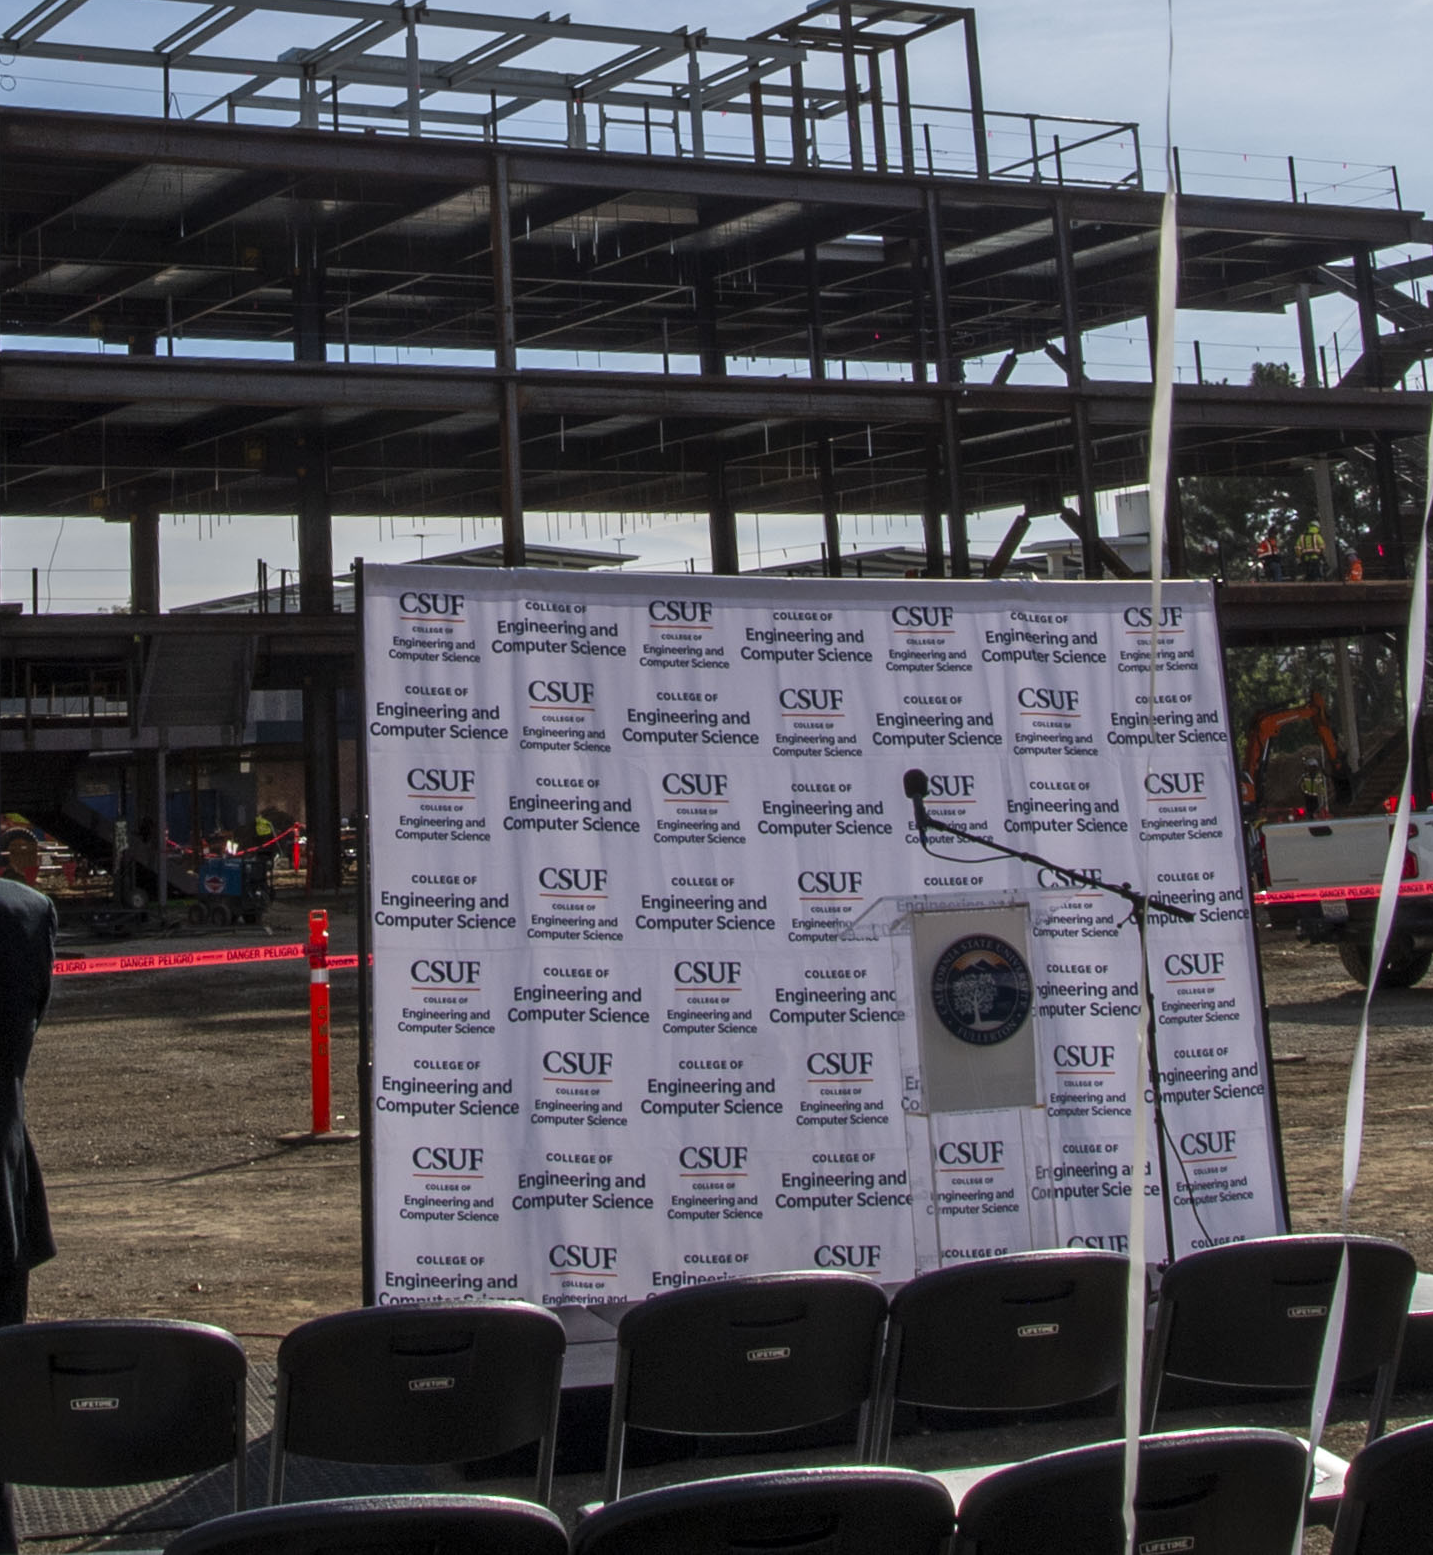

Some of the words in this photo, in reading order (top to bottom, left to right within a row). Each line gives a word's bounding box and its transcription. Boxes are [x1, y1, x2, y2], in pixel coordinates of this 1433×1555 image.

[400, 592, 464, 615] CSUF
[525, 601, 571, 613] COLLEGE
[574, 605, 586, 613] OF
[648, 601, 712, 622] CSUF
[892, 606, 953, 627] CSUF
[497, 618, 587, 639] Engineering
[590, 623, 618, 637] and
[492, 639, 568, 655] Computer
[570, 640, 626, 656] Science
[889, 649, 946, 661] Engineering
[948, 650, 966, 659] and
[886, 662, 934, 673] Computer
[936, 662, 972, 671] Science
[405, 685, 452, 696] COLLEGE
[454, 688, 468, 696] OF
[528, 681, 594, 704] CSUF
[779, 689, 842, 710] CSUF
[1018, 688, 1078, 711] CSUF
[904, 696, 948, 705] COLLEGE
[950, 696, 962, 704] OF
[377, 702, 467, 722] Engineering
[472, 705, 500, 720] and
[876, 712, 963, 729] Engineering
[967, 712, 994, 726] and
[370, 722, 446, 739] Computer
[450, 722, 508, 739] Science
[872, 732, 946, 748] Computer
[948, 731, 1002, 745] Science
[407, 769, 475, 792] CSUF
[662, 773, 727, 795] CSUF
[1030, 781, 1076, 790] COLLEGE
[1078, 782, 1090, 790] OF
[1144, 773, 1204, 794] CSUF
[1007, 798, 1092, 815] Engineering
[1094, 799, 1119, 813] and
[1004, 819, 1073, 834] Computer
[1077, 818, 1128, 832] Science
[1141, 818, 1198, 830] Engineering
[1200, 817, 1217, 826] and
[1139, 832, 1186, 842] Computer
[1188, 830, 1222, 839] Science
[539, 867, 607, 891] CSUF
[672, 877, 718, 887] COLLEGE
[721, 878, 734, 886] OF
[798, 871, 862, 893] CSUF
[642, 895, 734, 913] Engineering
[738, 895, 767, 910] and
[636, 915, 713, 933] Computer
[717, 915, 775, 930] Science
[53, 961, 87, 973] ELIGRO
[120, 957, 155, 969] DANGER
[158, 954, 194, 966] PELIGRO
[226, 949, 261, 961] DANGER
[264, 946, 299, 958] PELIGRO
[1164, 953, 1224, 976] CSUF
[411, 960, 480, 983] CSUF
[544, 967, 592, 977] COLLEGE
[596, 969, 609, 977] OF
[674, 961, 741, 983] CSUF
[514, 984, 608, 1005] Engineering
[612, 987, 641, 1002] and
[403, 1008, 467, 1022] Engineering
[470, 1010, 490, 1020] and
[508, 1008, 586, 1023] Computer
[589, 1007, 650, 1023] Science
[398, 1022, 452, 1035] Computer
[455, 1021, 495, 1033] Science
[414, 1060, 463, 1070] COLLEGE
[467, 1061, 480, 1070] OF
[543, 1051, 612, 1075] CSUF
[807, 1053, 873, 1075] CSUF
[1054, 1045, 1114, 1067] CSUF
[382, 1076, 478, 1098] Engineering
[482, 1079, 512, 1094] and
[376, 1096, 456, 1117] Computer
[460, 1096, 519, 1115] Science
[535, 1099, 599, 1114] Engineering
[602, 1102, 622, 1112] and
[530, 1114, 584, 1126] Computer
[587, 1115, 627, 1126] Science
[1180, 1130, 1236, 1155] CSUF
[412, 1147, 484, 1171] CSUF
[679, 1147, 748, 1169] CSUF
[812, 1153, 859, 1163] COLLEGE
[862, 1153, 875, 1162] OF
[939, 1141, 1004, 1164] CSUF
[782, 1171, 874, 1191] Engineering
[878, 1170, 906, 1185] and
[776, 1193, 853, 1211] Computer
[857, 1191, 914, 1207] Science
[549, 1245, 617, 1269] CSUF
[814, 1245, 880, 1269] CSUF
[1290, 1307, 1324, 1316] LIFETIME
[1020, 1325, 1057, 1335] LIFETIME
[748, 1348, 785, 1359] LIFETIME
[412, 1379, 450, 1389] LIFETIME
[74, 1400, 115, 1409] LIFETIME
[1143, 1539, 1189, 1554] LIFETIME
